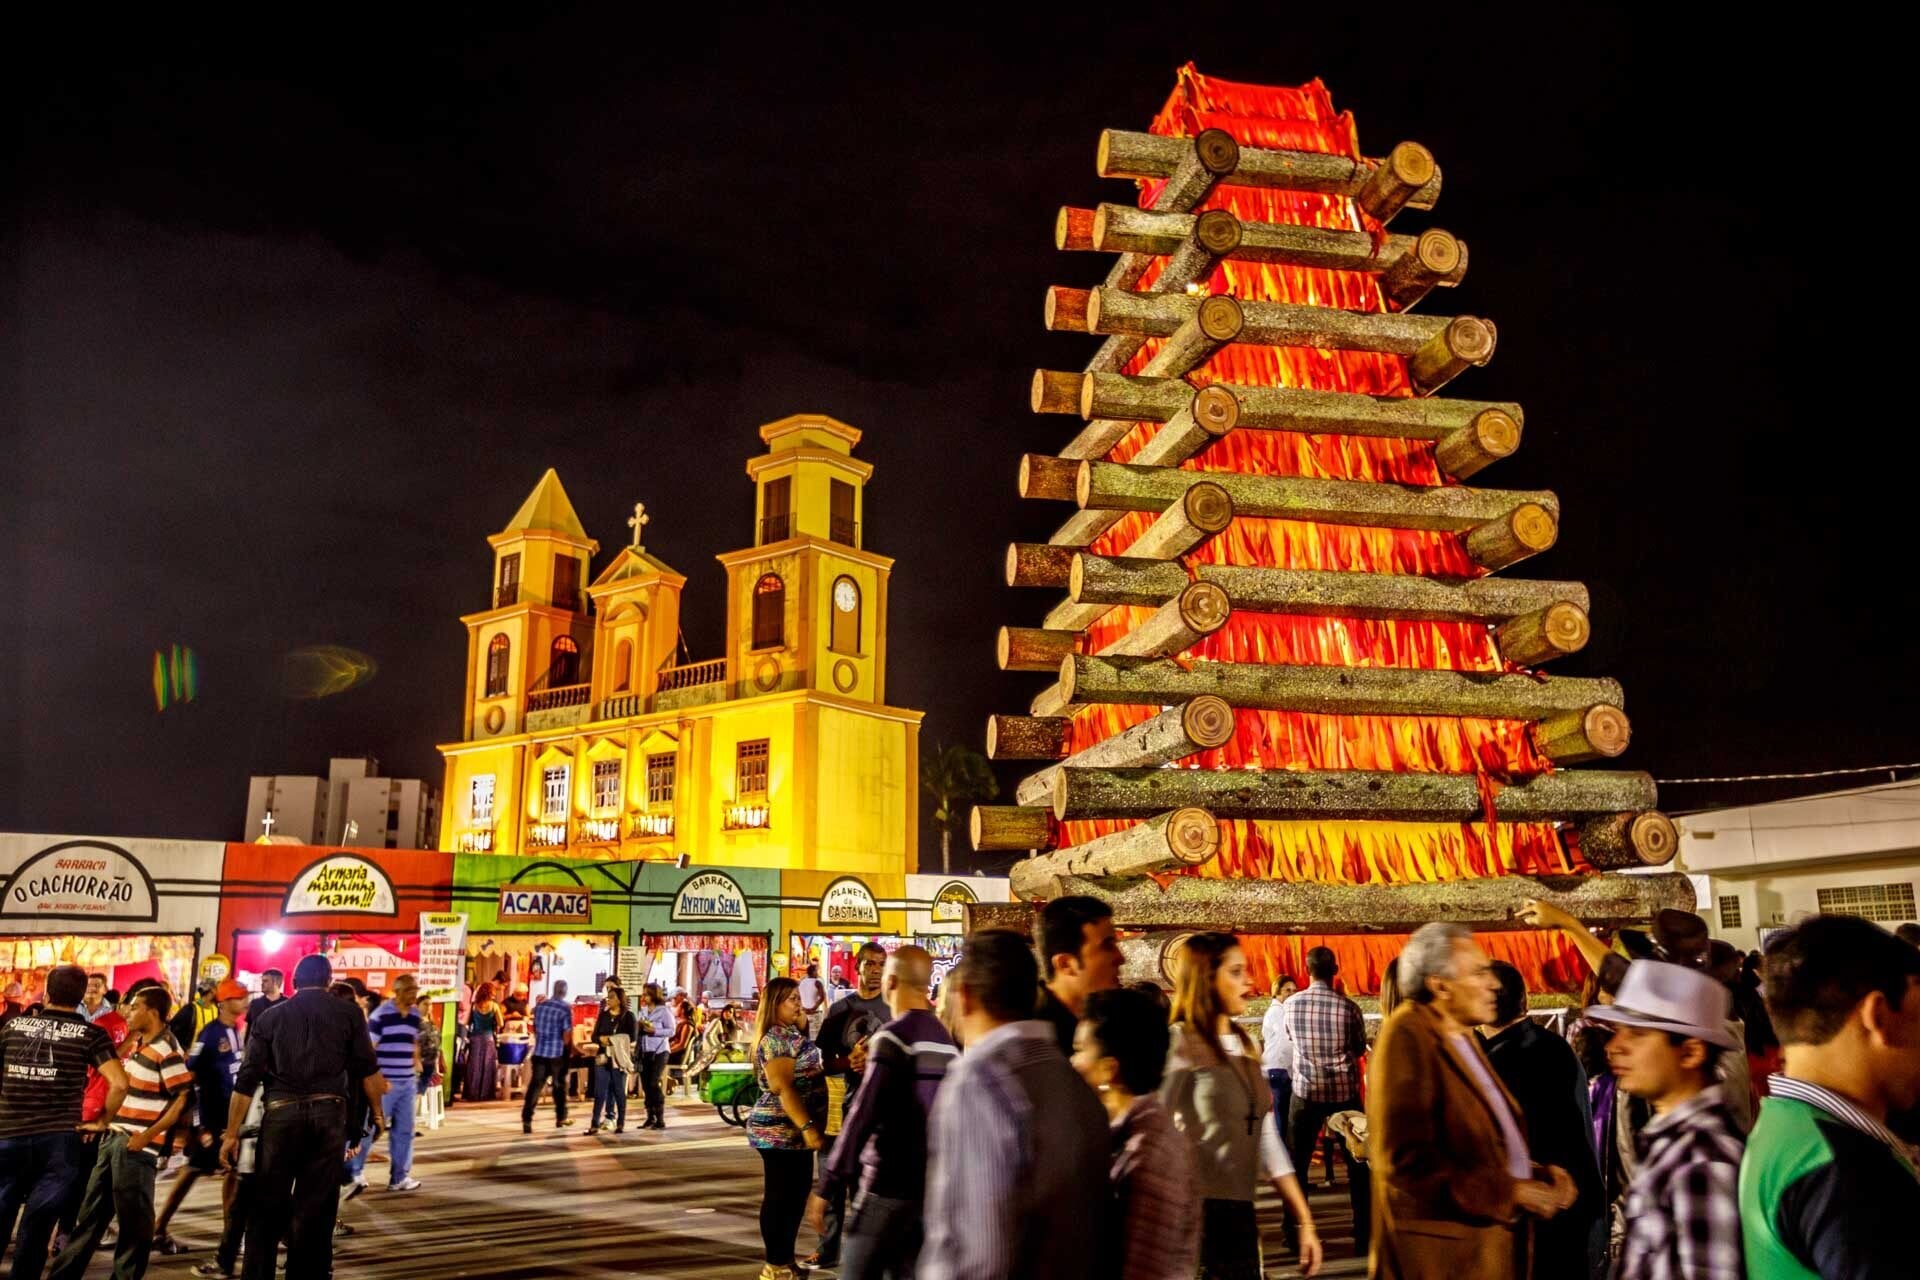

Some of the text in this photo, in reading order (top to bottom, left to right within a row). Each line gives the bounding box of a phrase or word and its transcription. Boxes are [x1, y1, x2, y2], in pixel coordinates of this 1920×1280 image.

[55, 859, 106, 870] BARRACA
[317, 864, 367, 881] Armaria
[14, 874, 132, 902] O CACHORRÃO
[692, 876, 733, 892] BARRACA
[317, 891, 375, 907] nam!!!
[831, 887, 868, 901] PLANETA
[680, 893, 741, 913] AYRTON SENA
[828, 905, 873, 920] CASTANHA
[60, 1022, 88, 1037] COVE
[37, 1067, 58, 1077] YACHT
